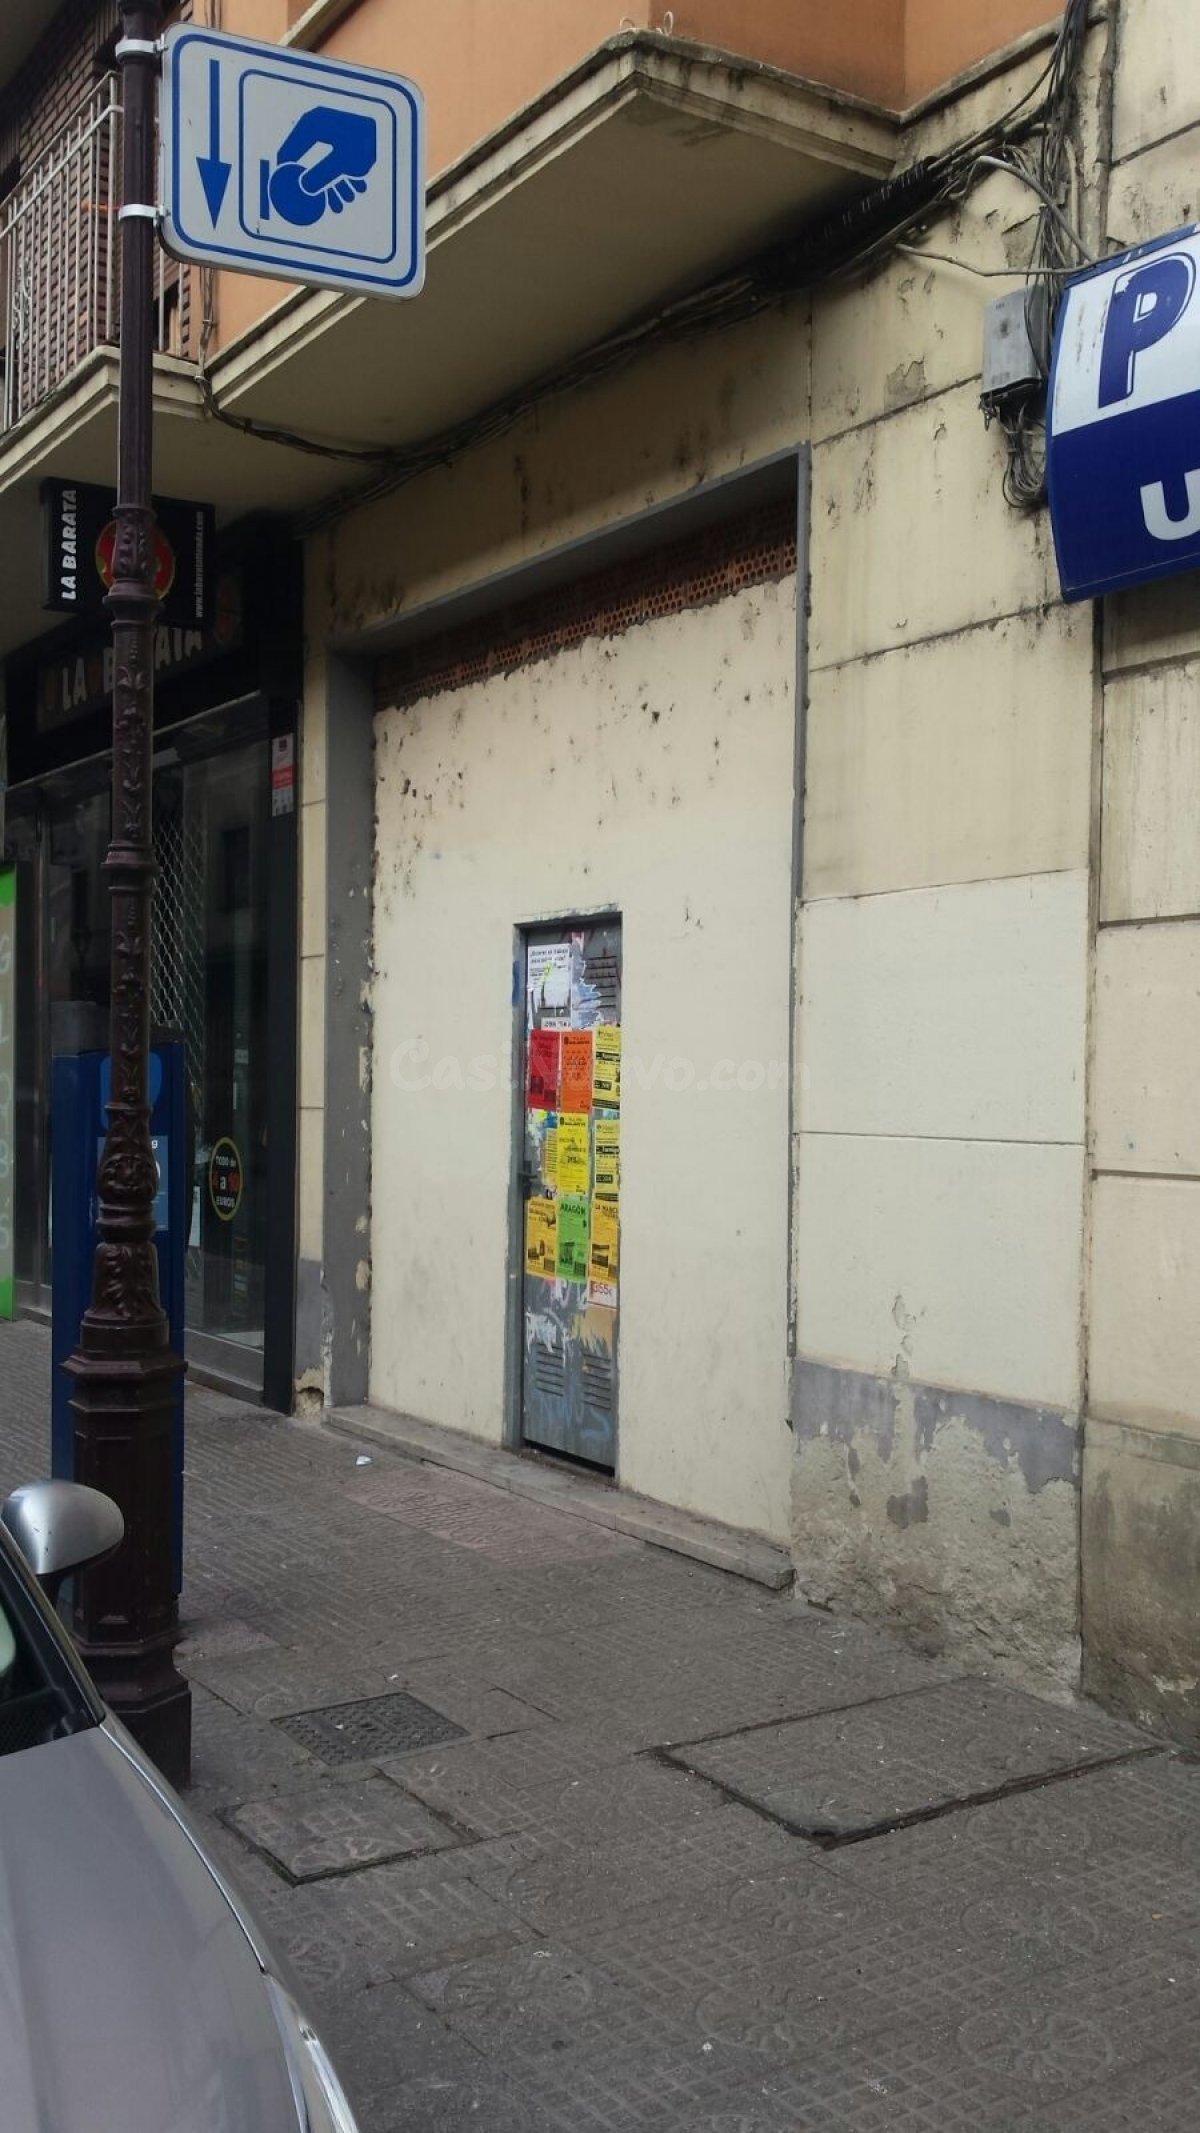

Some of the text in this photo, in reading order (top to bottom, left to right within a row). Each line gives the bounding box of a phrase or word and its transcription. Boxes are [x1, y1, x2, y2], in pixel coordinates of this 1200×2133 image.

[61, 489, 77, 600] LA BARATA
[62, 657, 87, 712] LA
